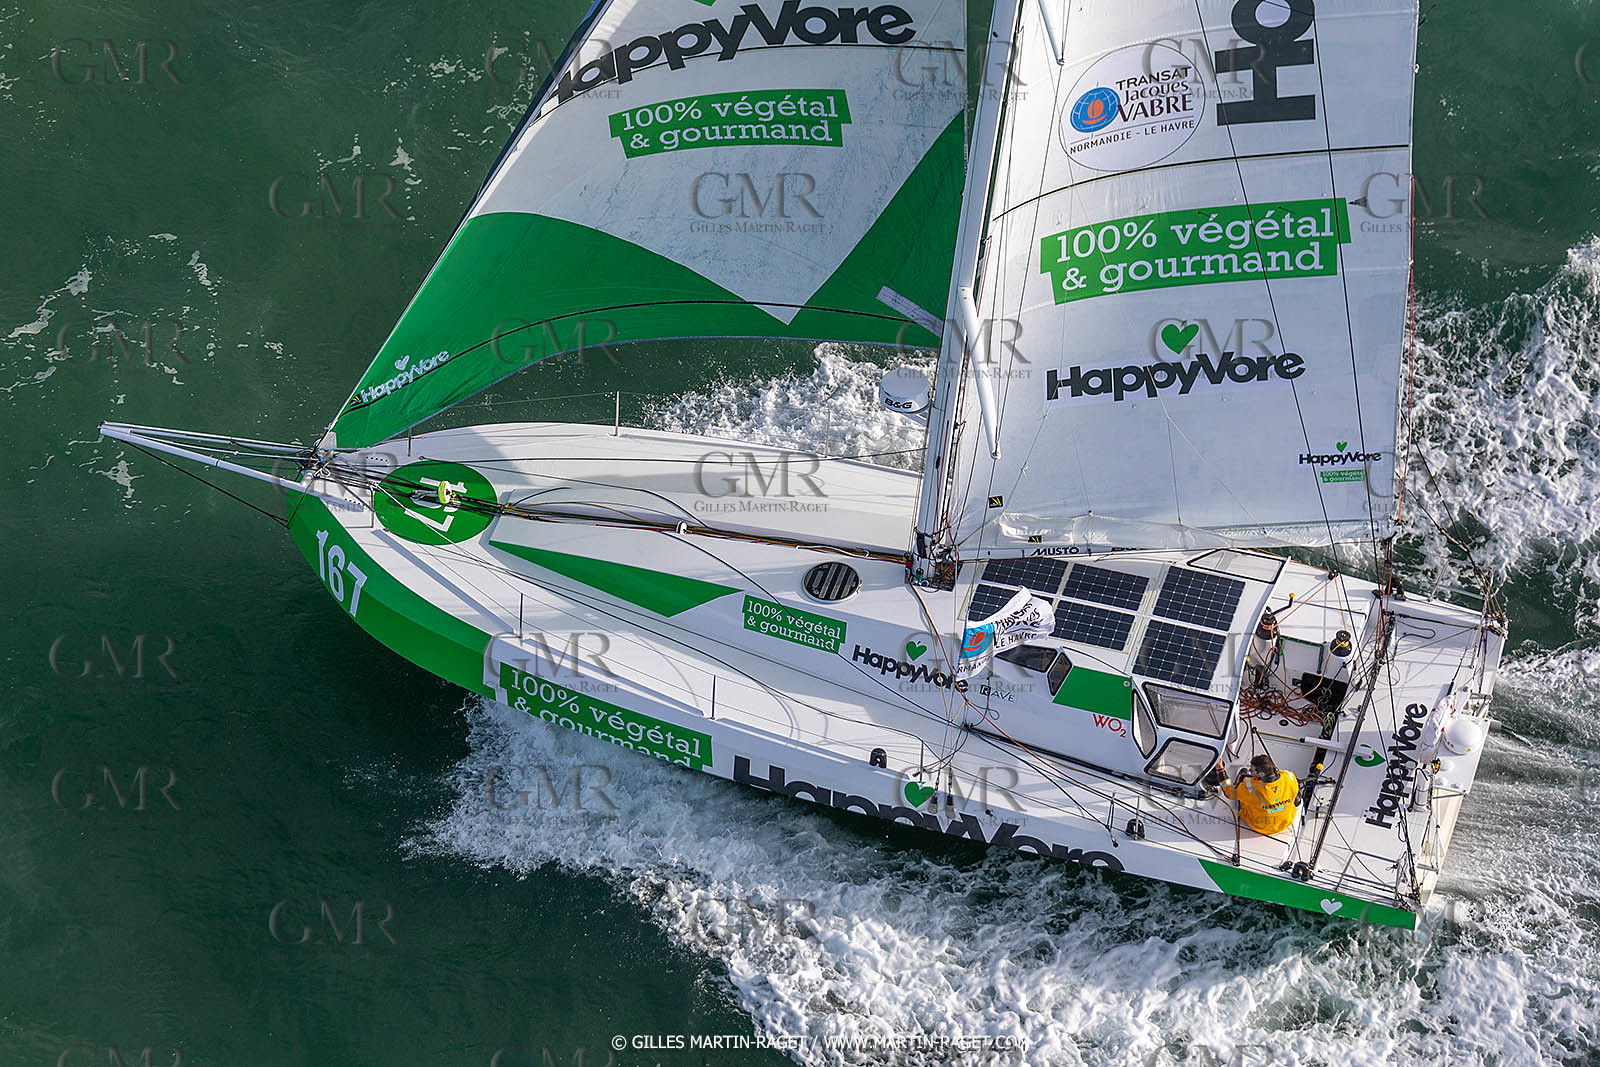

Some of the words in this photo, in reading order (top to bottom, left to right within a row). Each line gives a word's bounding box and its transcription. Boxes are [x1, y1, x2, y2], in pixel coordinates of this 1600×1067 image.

[1116, 66, 1192, 90] TRANSAT
[1124, 80, 1189, 106] Jacques
[622, 100, 702, 131] 100%
[712, 96, 838, 122] végétal
[1117, 93, 1194, 122] VABRE
[630, 134, 650, 149] &
[659, 121, 832, 150] gourmand
[1070, 131, 1132, 154] NORMANDIE
[1144, 125, 1157, 136] LE
[1161, 120, 1195, 133] HAVRE
[1057, 220, 1157, 263] 100%
[1170, 208, 1334, 249] végétal
[1062, 267, 1087, 291] &
[1100, 241, 1324, 293] gourmand
[360, 350, 449, 402] HappyVore
[1047, 352, 1306, 402] HappyVore
[885, 398, 912, 409] B&G
[1299, 452, 1381, 466] HappyVore
[1031, 546, 1079, 556] MUSTO
[316, 529, 368, 617] 167
[747, 600, 783, 621] 100%
[787, 616, 840, 639] végétal
[747, 616, 756, 626] &
[760, 621, 835, 650] gourmand
[852, 645, 969, 693] HappyVore
[512, 670, 579, 713] 100%
[589, 706, 701, 758] végétal
[514, 697, 531, 714] &
[1365, 703, 1428, 829] HappyVore
